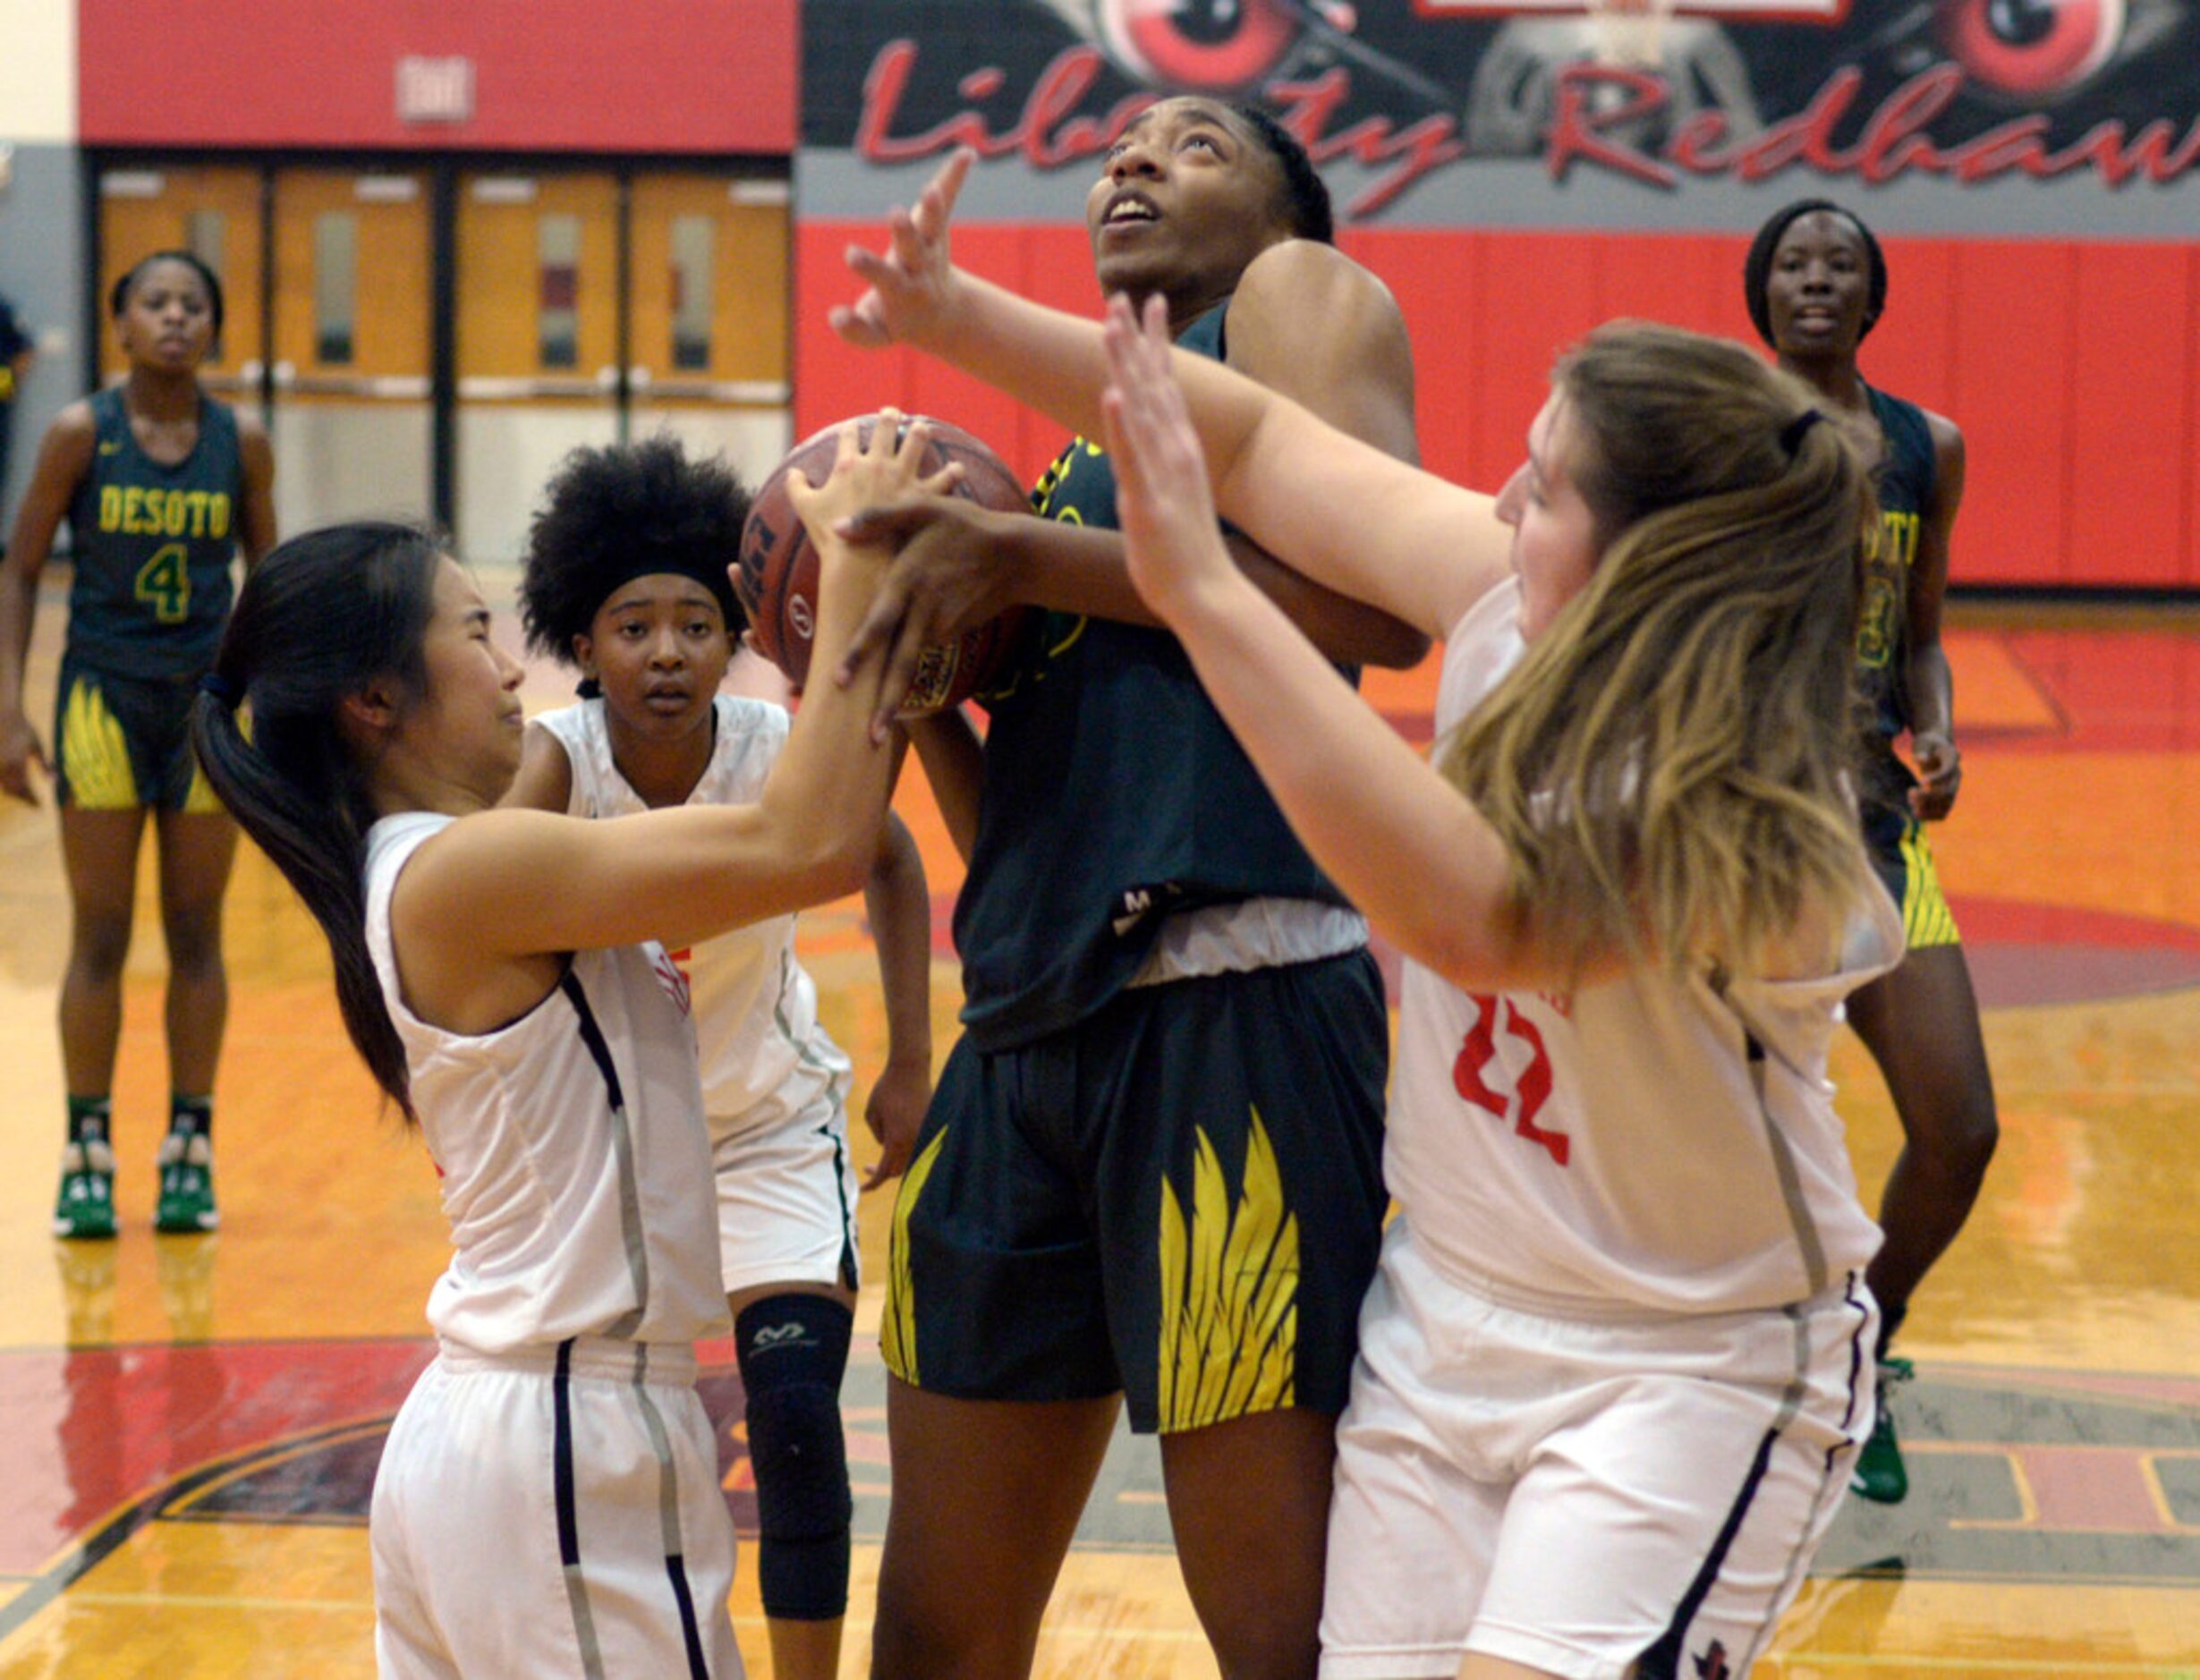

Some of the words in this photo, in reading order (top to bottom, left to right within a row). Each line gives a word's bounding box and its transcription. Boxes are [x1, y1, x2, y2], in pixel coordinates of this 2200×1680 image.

[855, 38, 1468, 220] Libty
[99, 484, 231, 539] DESOTO
[135, 542, 191, 624] 4
[1452, 995, 1572, 1168] 22
